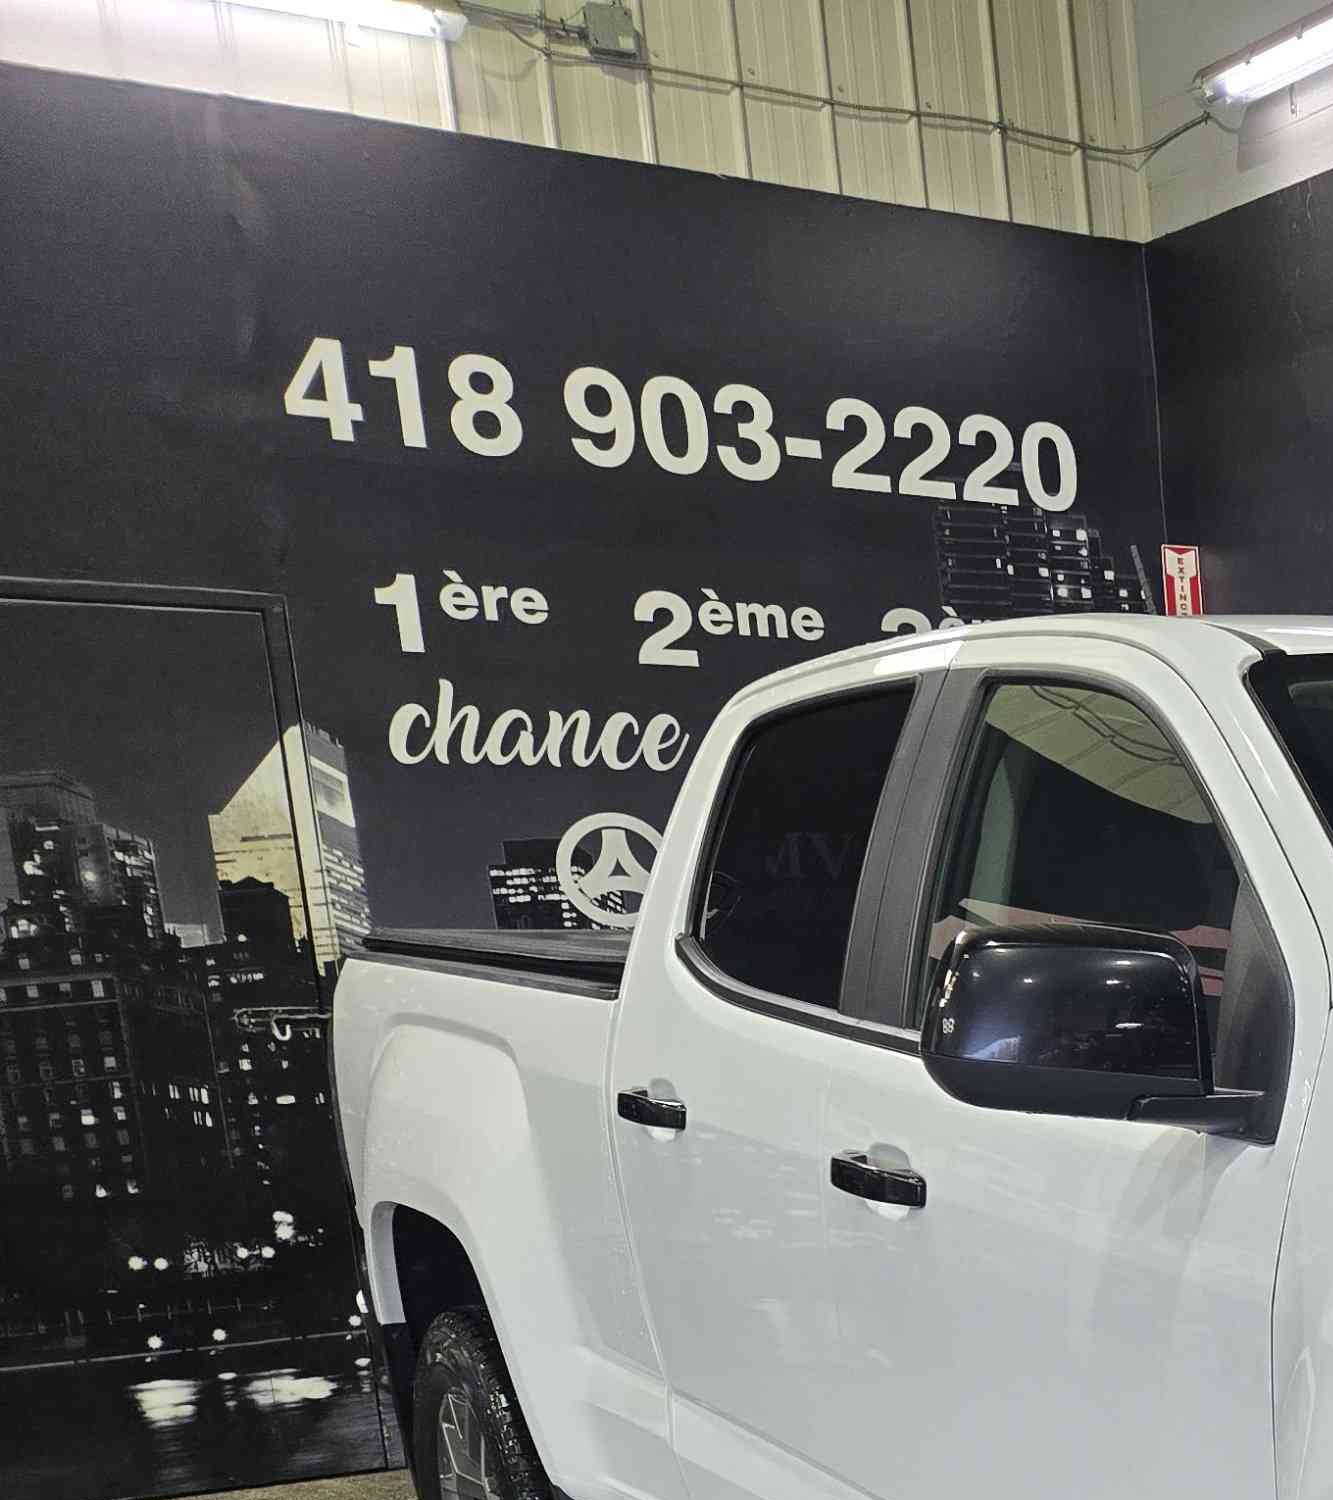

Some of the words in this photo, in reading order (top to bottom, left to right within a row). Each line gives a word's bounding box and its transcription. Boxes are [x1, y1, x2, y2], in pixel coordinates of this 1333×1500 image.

[283, 336, 523, 458] 418
[563, 366, 1078, 512] 903-2220
[374, 570, 549, 653] 1ère
[633, 588, 826, 668] 2ème
[1177, 557, 1188, 615] EXTINC
[388, 678, 690, 772] chance
